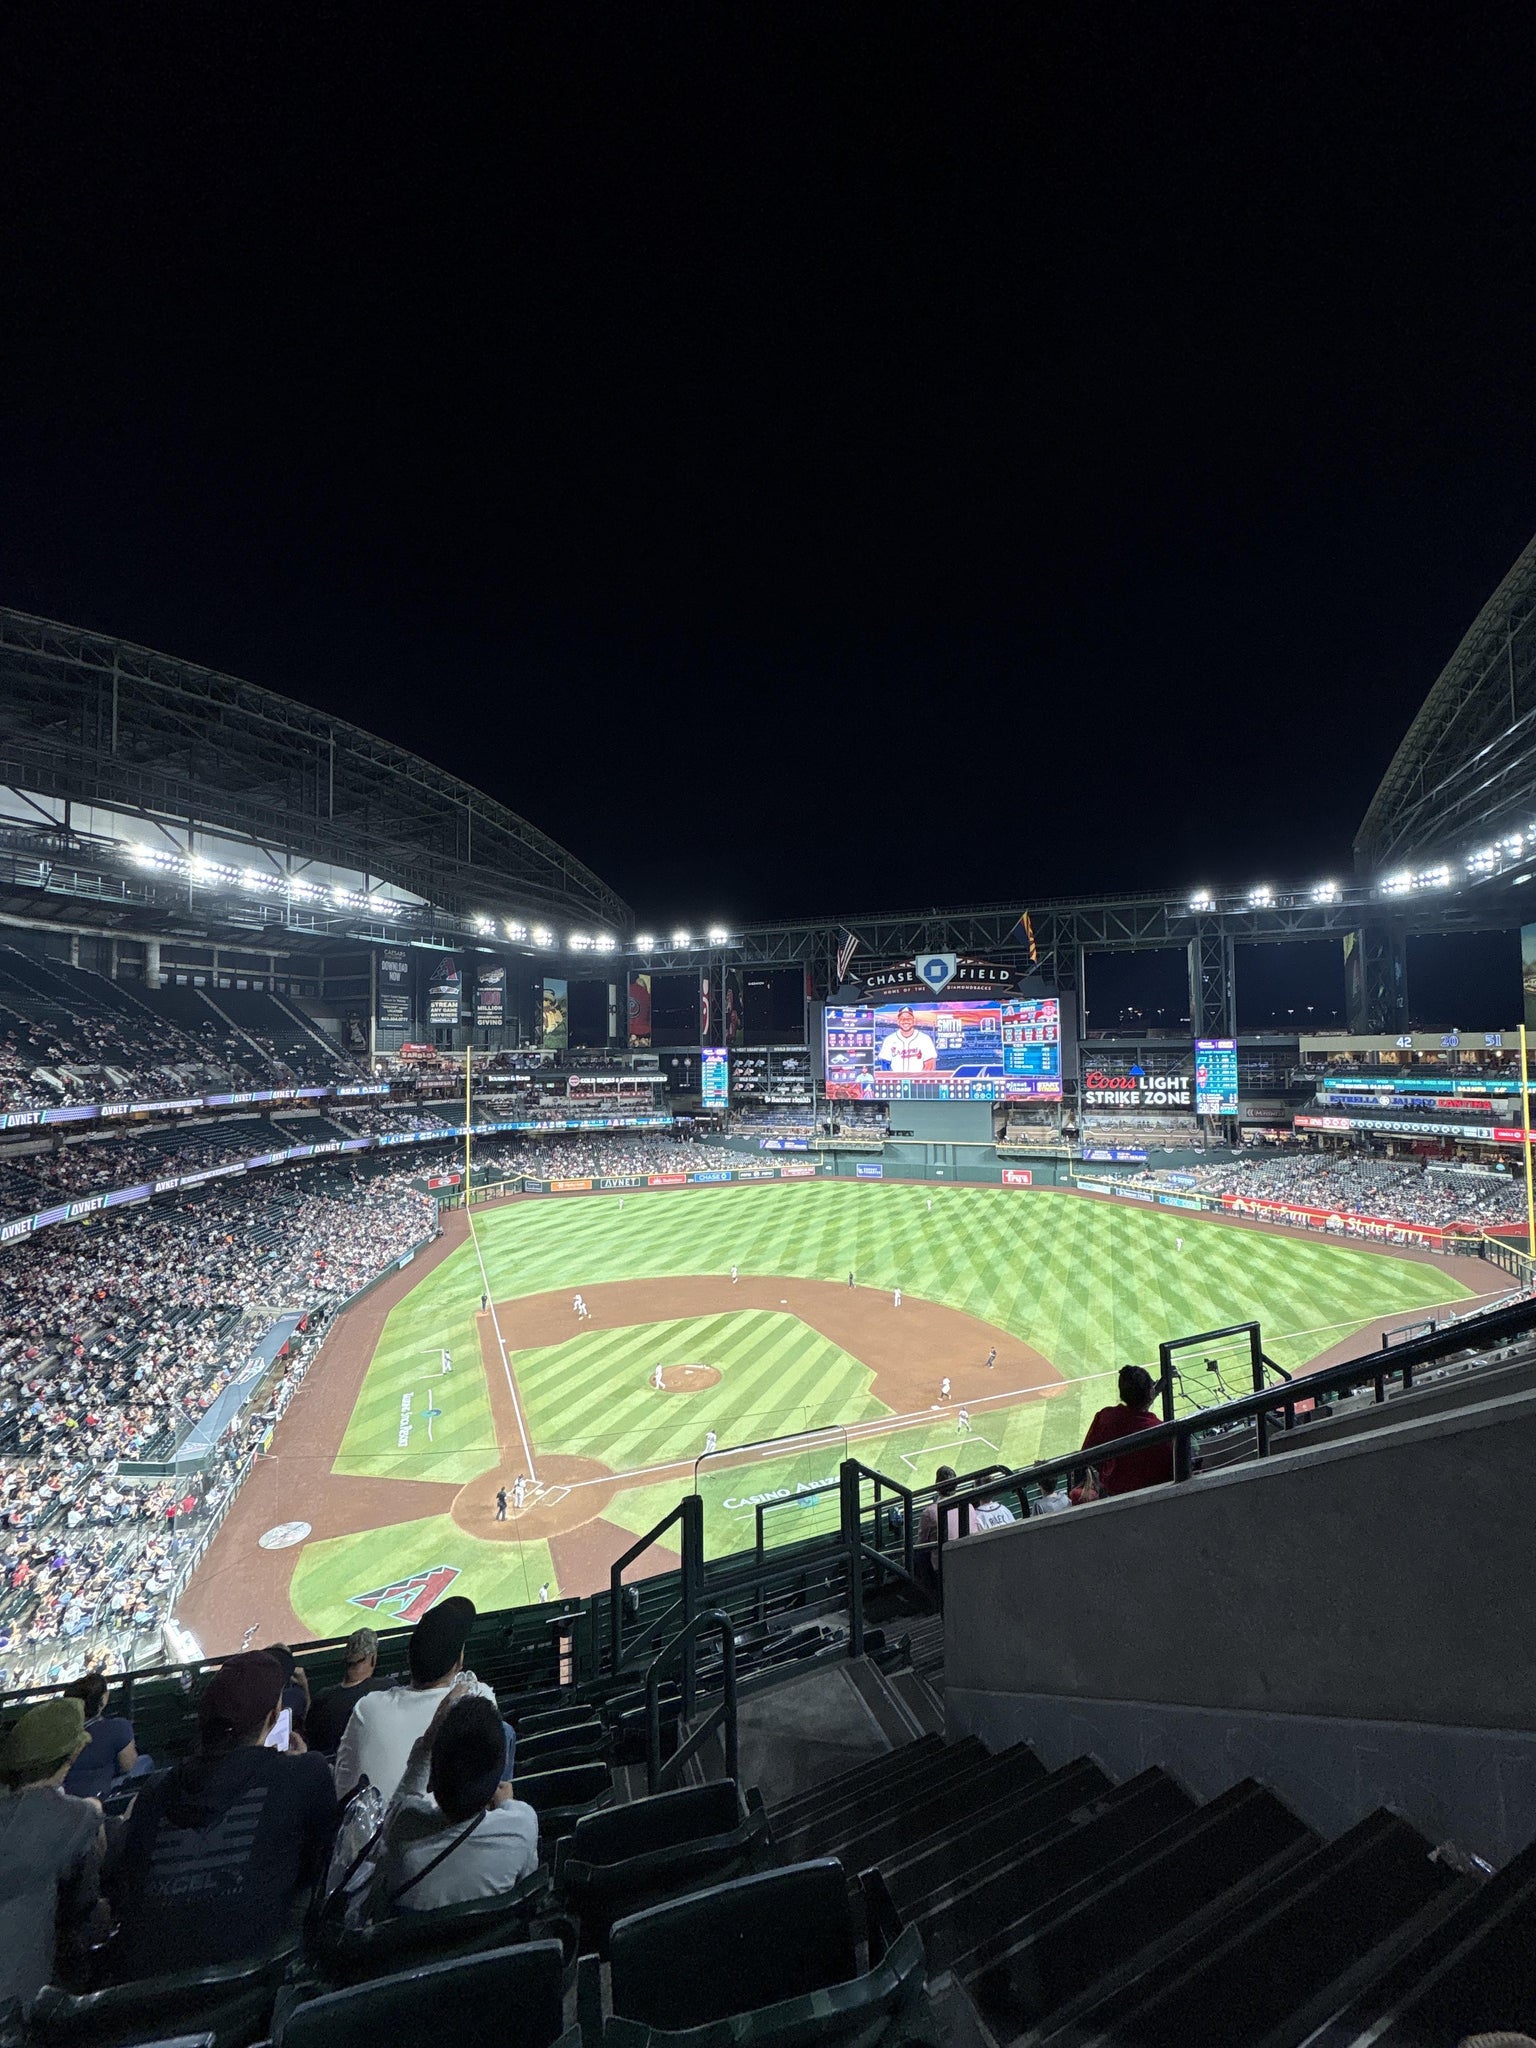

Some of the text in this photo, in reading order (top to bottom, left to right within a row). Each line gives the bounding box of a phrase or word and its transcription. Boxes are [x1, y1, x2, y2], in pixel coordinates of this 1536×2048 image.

[381, 960, 408, 973] DOWNLOAD
[389, 971, 401, 982] NOW
[867, 968, 1009, 986] CHASE FIELD
[938, 1019, 962, 1032] SMITH
[1396, 1034, 1502, 1048] 42 20 51
[1085, 1071, 1190, 1090] Coors LIGHT
[792, 1096, 811, 1104] Health
[1085, 1091, 1140, 1105] STRIKE
[1144, 1091, 1191, 1105] ZONE
[1329, 1095, 1378, 1104] ESTRELLA
[102, 1104, 128, 1116] AVNET
[7, 1112, 41, 1128] AVNET
[314, 1142, 341, 1154] AVNET
[605, 1178, 637, 1188] AVNET
[699, 1172, 720, 1181] CHASE
[1005, 1169, 1029, 1183] fry's
[154, 1177, 180, 1193] AVNET
[71, 1197, 104, 1216] AVNET
[0, 1218, 34, 1241] AVNET
[722, 1488, 791, 1509] CASINO
